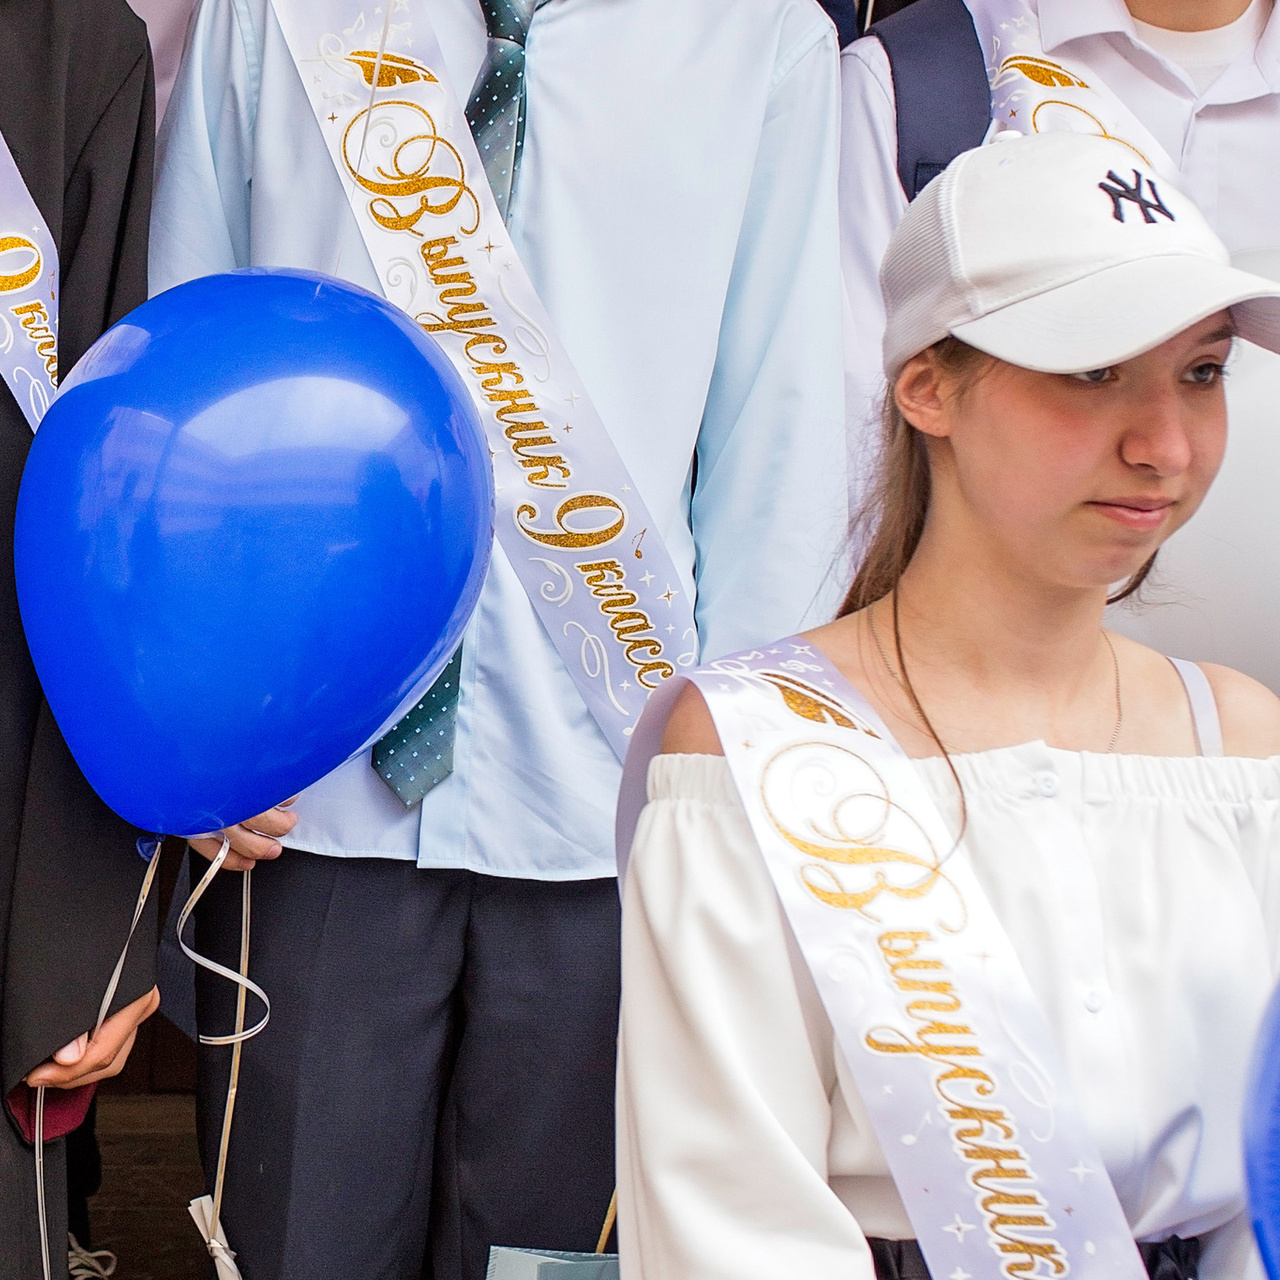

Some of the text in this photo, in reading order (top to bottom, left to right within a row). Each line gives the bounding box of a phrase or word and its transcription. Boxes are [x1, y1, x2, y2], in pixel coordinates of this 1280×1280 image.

[341, 99, 675, 690] Выпускник 9 класс
